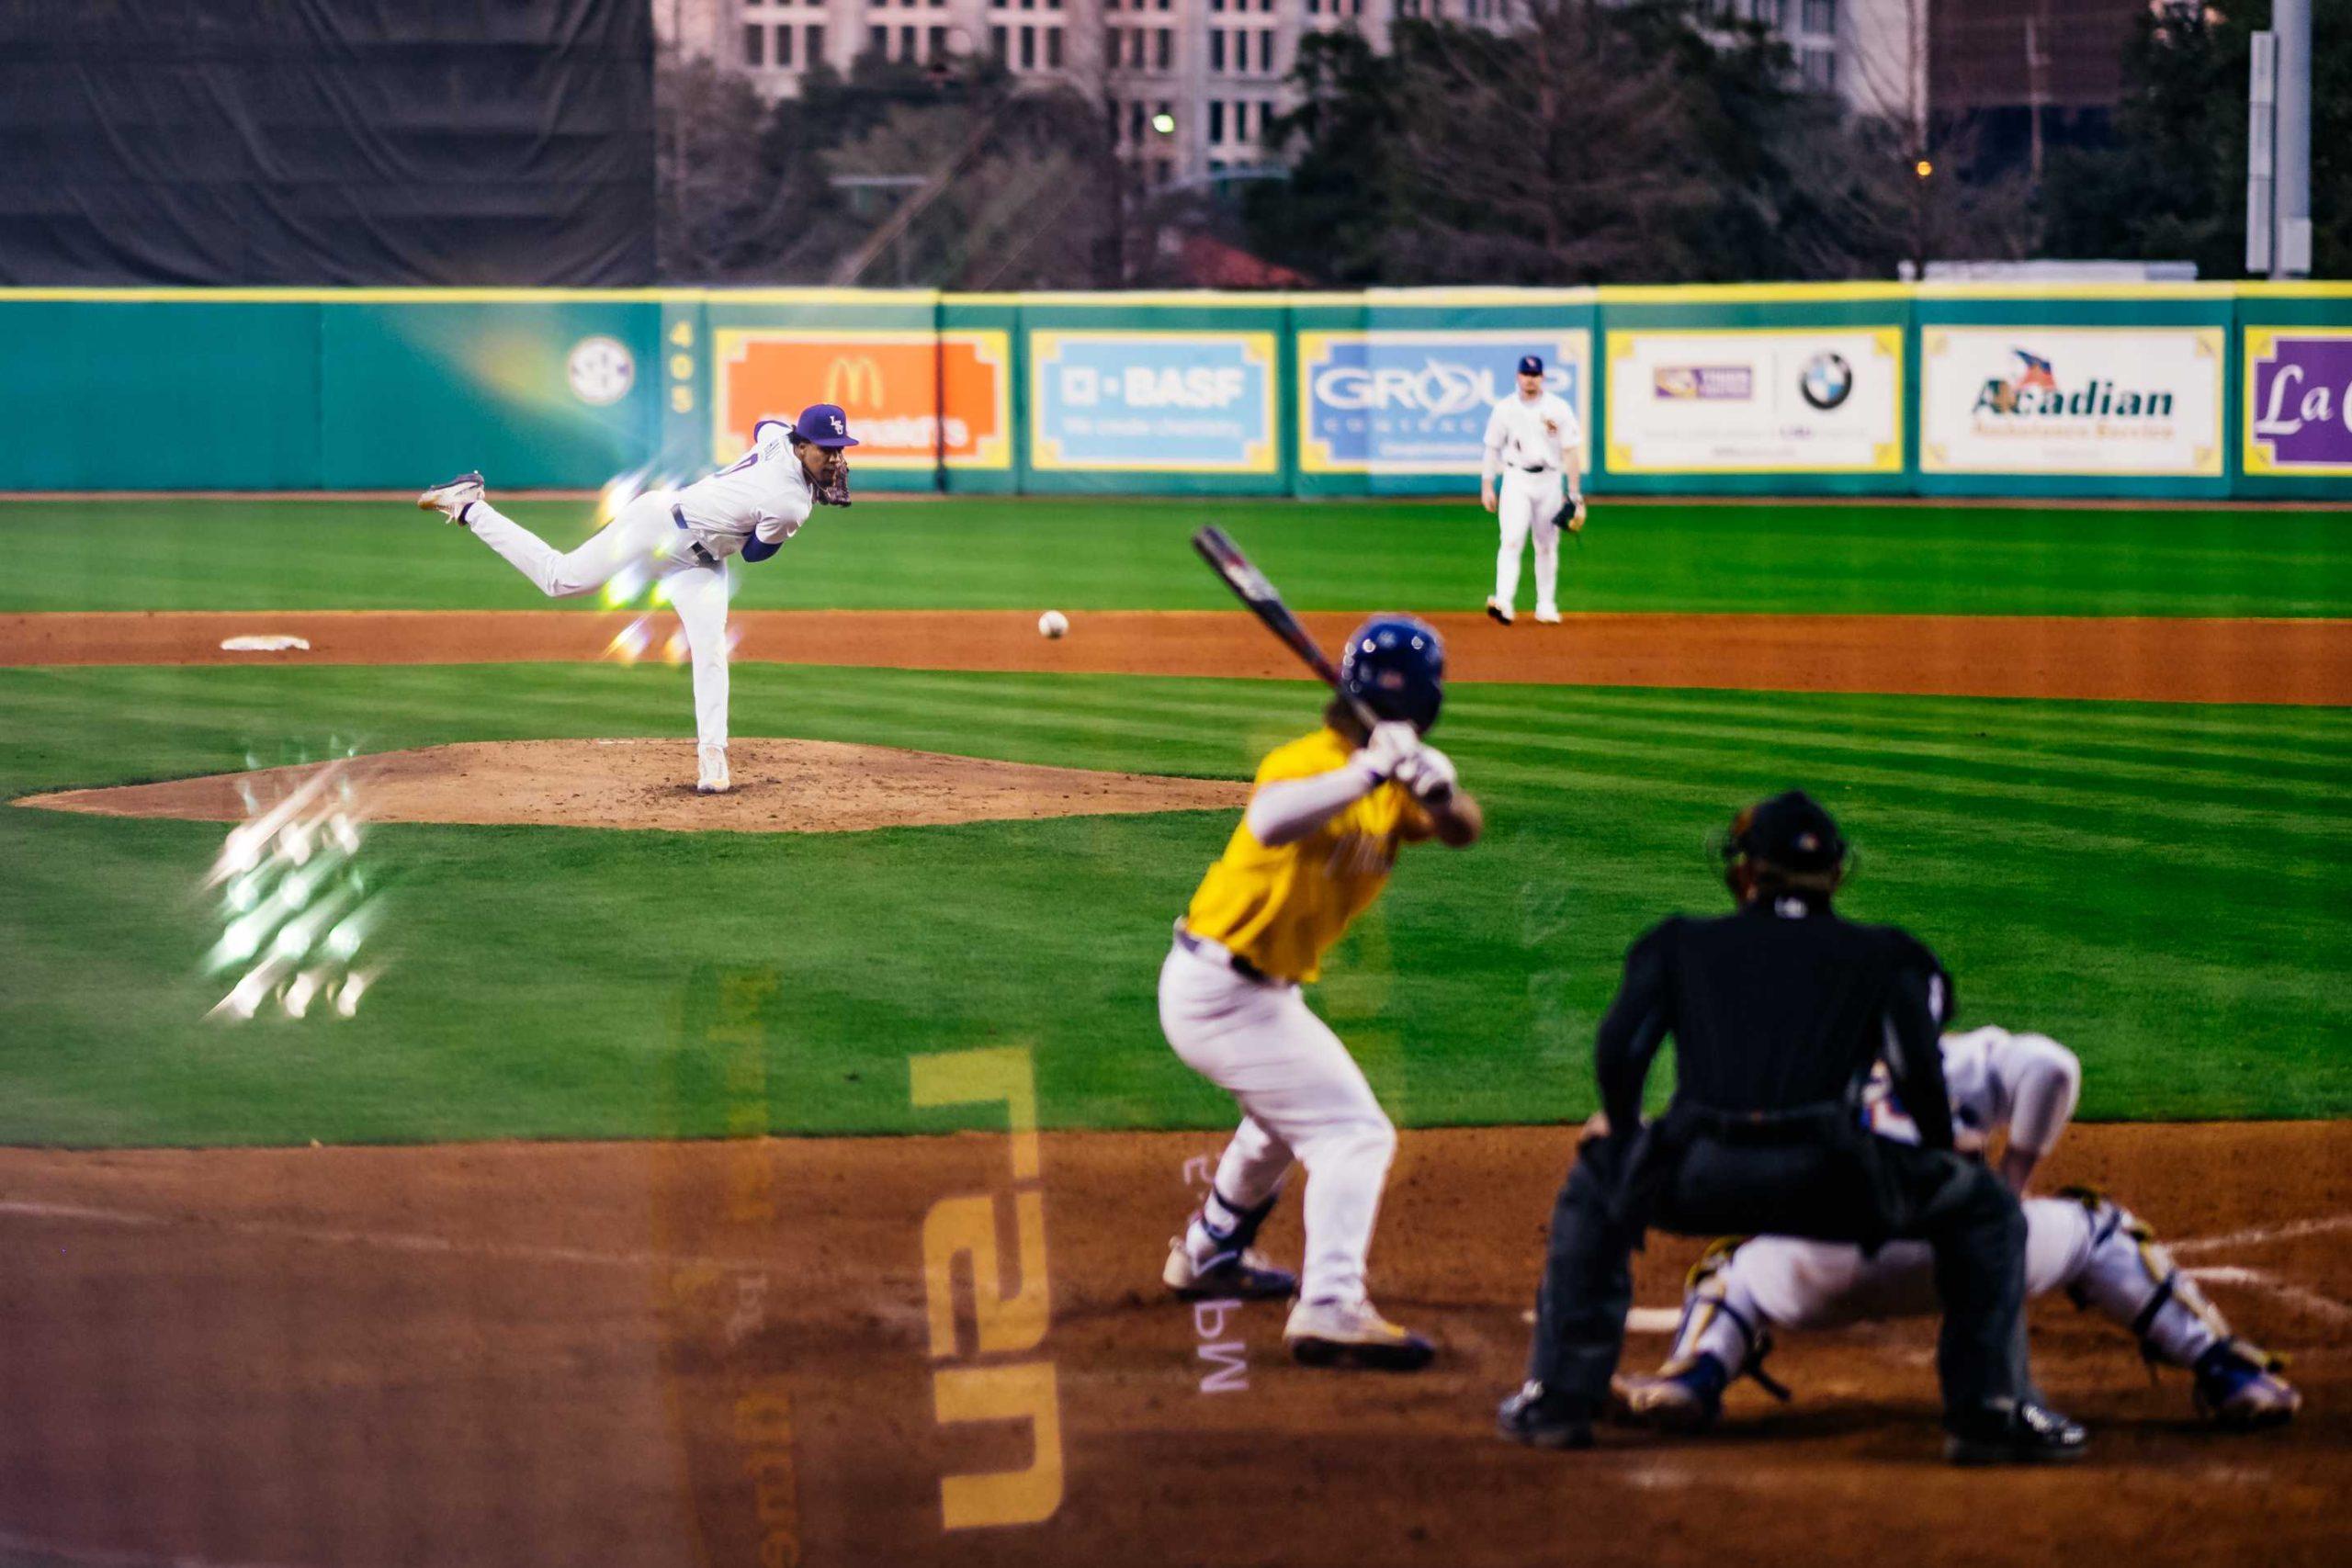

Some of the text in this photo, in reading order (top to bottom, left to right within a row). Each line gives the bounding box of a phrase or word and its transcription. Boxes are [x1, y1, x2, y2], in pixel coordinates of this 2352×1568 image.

[1125, 366, 1245, 408] BASF
[1973, 378, 2174, 416] Acadian
[2254, 364, 2335, 435] La
[829, 415, 844, 435] LSU
